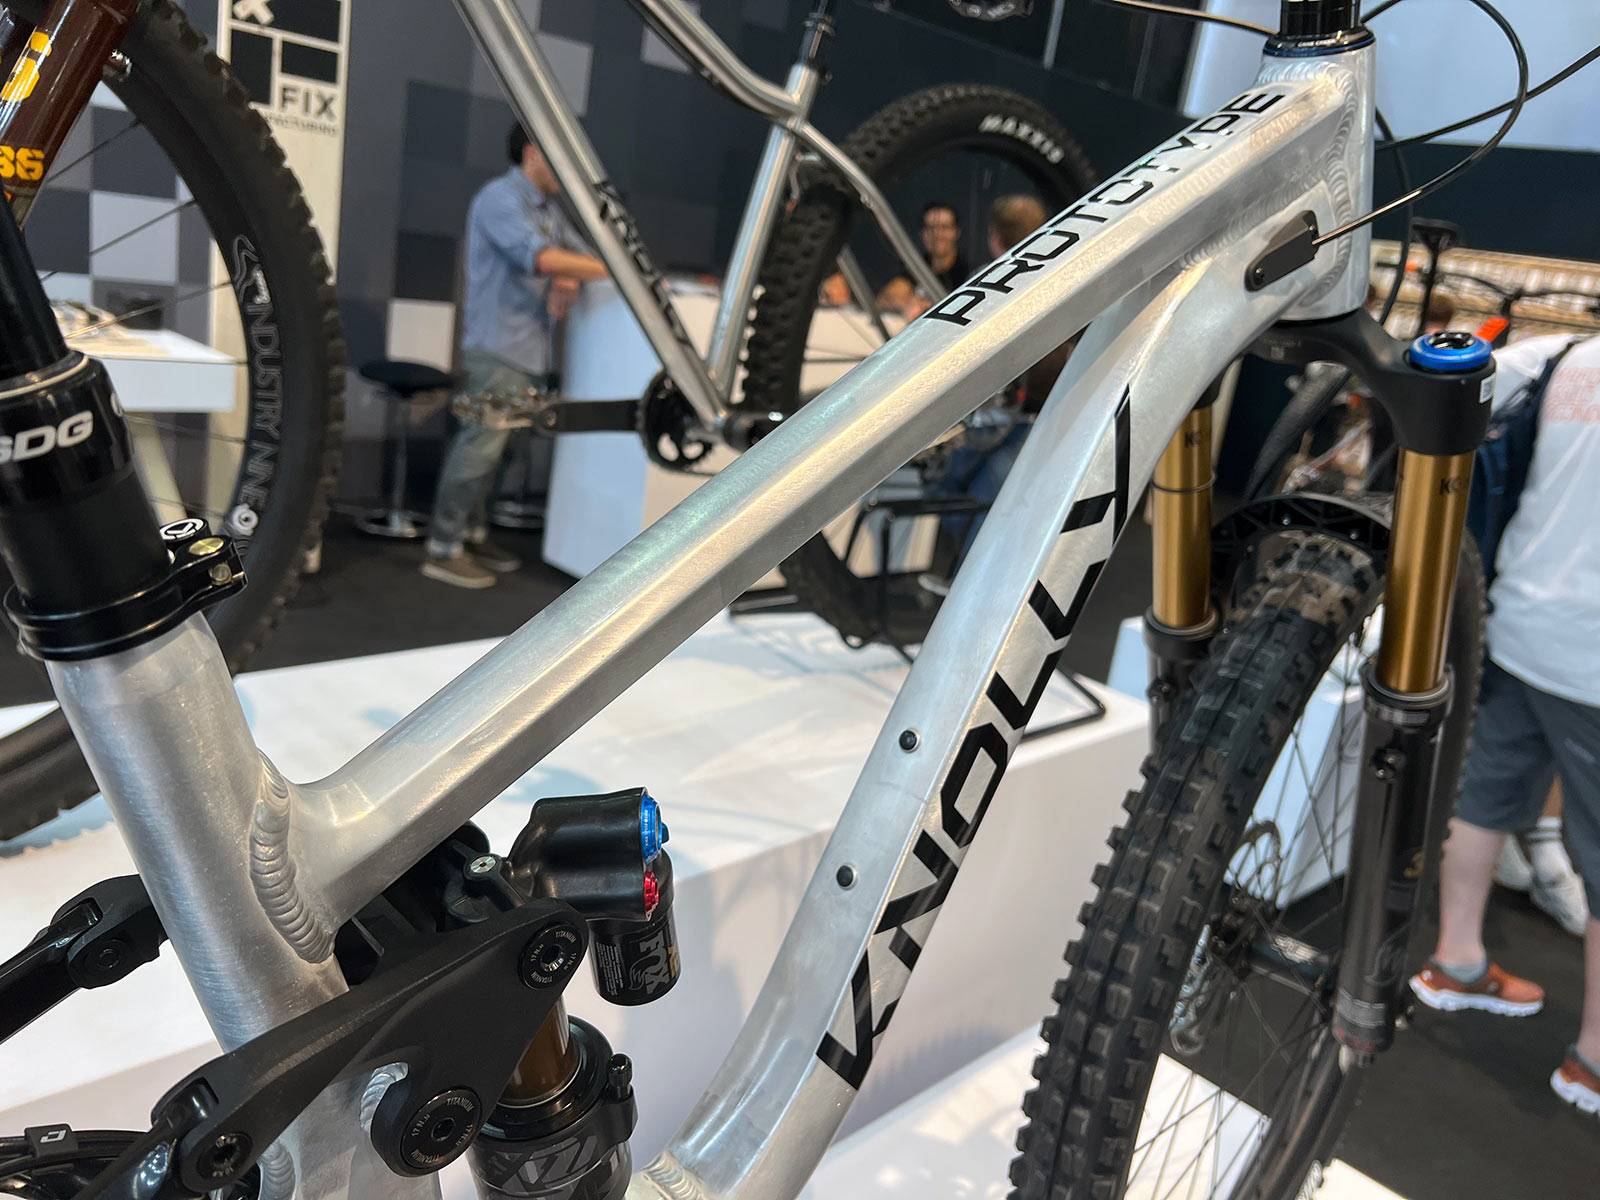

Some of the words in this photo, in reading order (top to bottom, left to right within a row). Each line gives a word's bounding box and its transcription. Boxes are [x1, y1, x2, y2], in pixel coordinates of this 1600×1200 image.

[280, 84, 338, 120] FIX
[978, 114, 1065, 164] MAXXIS
[924, 92, 1286, 327] PROTOTYPE
[246, 302, 283, 440] INDUSTRY
[815, 384, 1131, 1091] KNOLLY
[629, 929, 671, 996] FOX
[446, 1096, 475, 1113] TITANIUM
